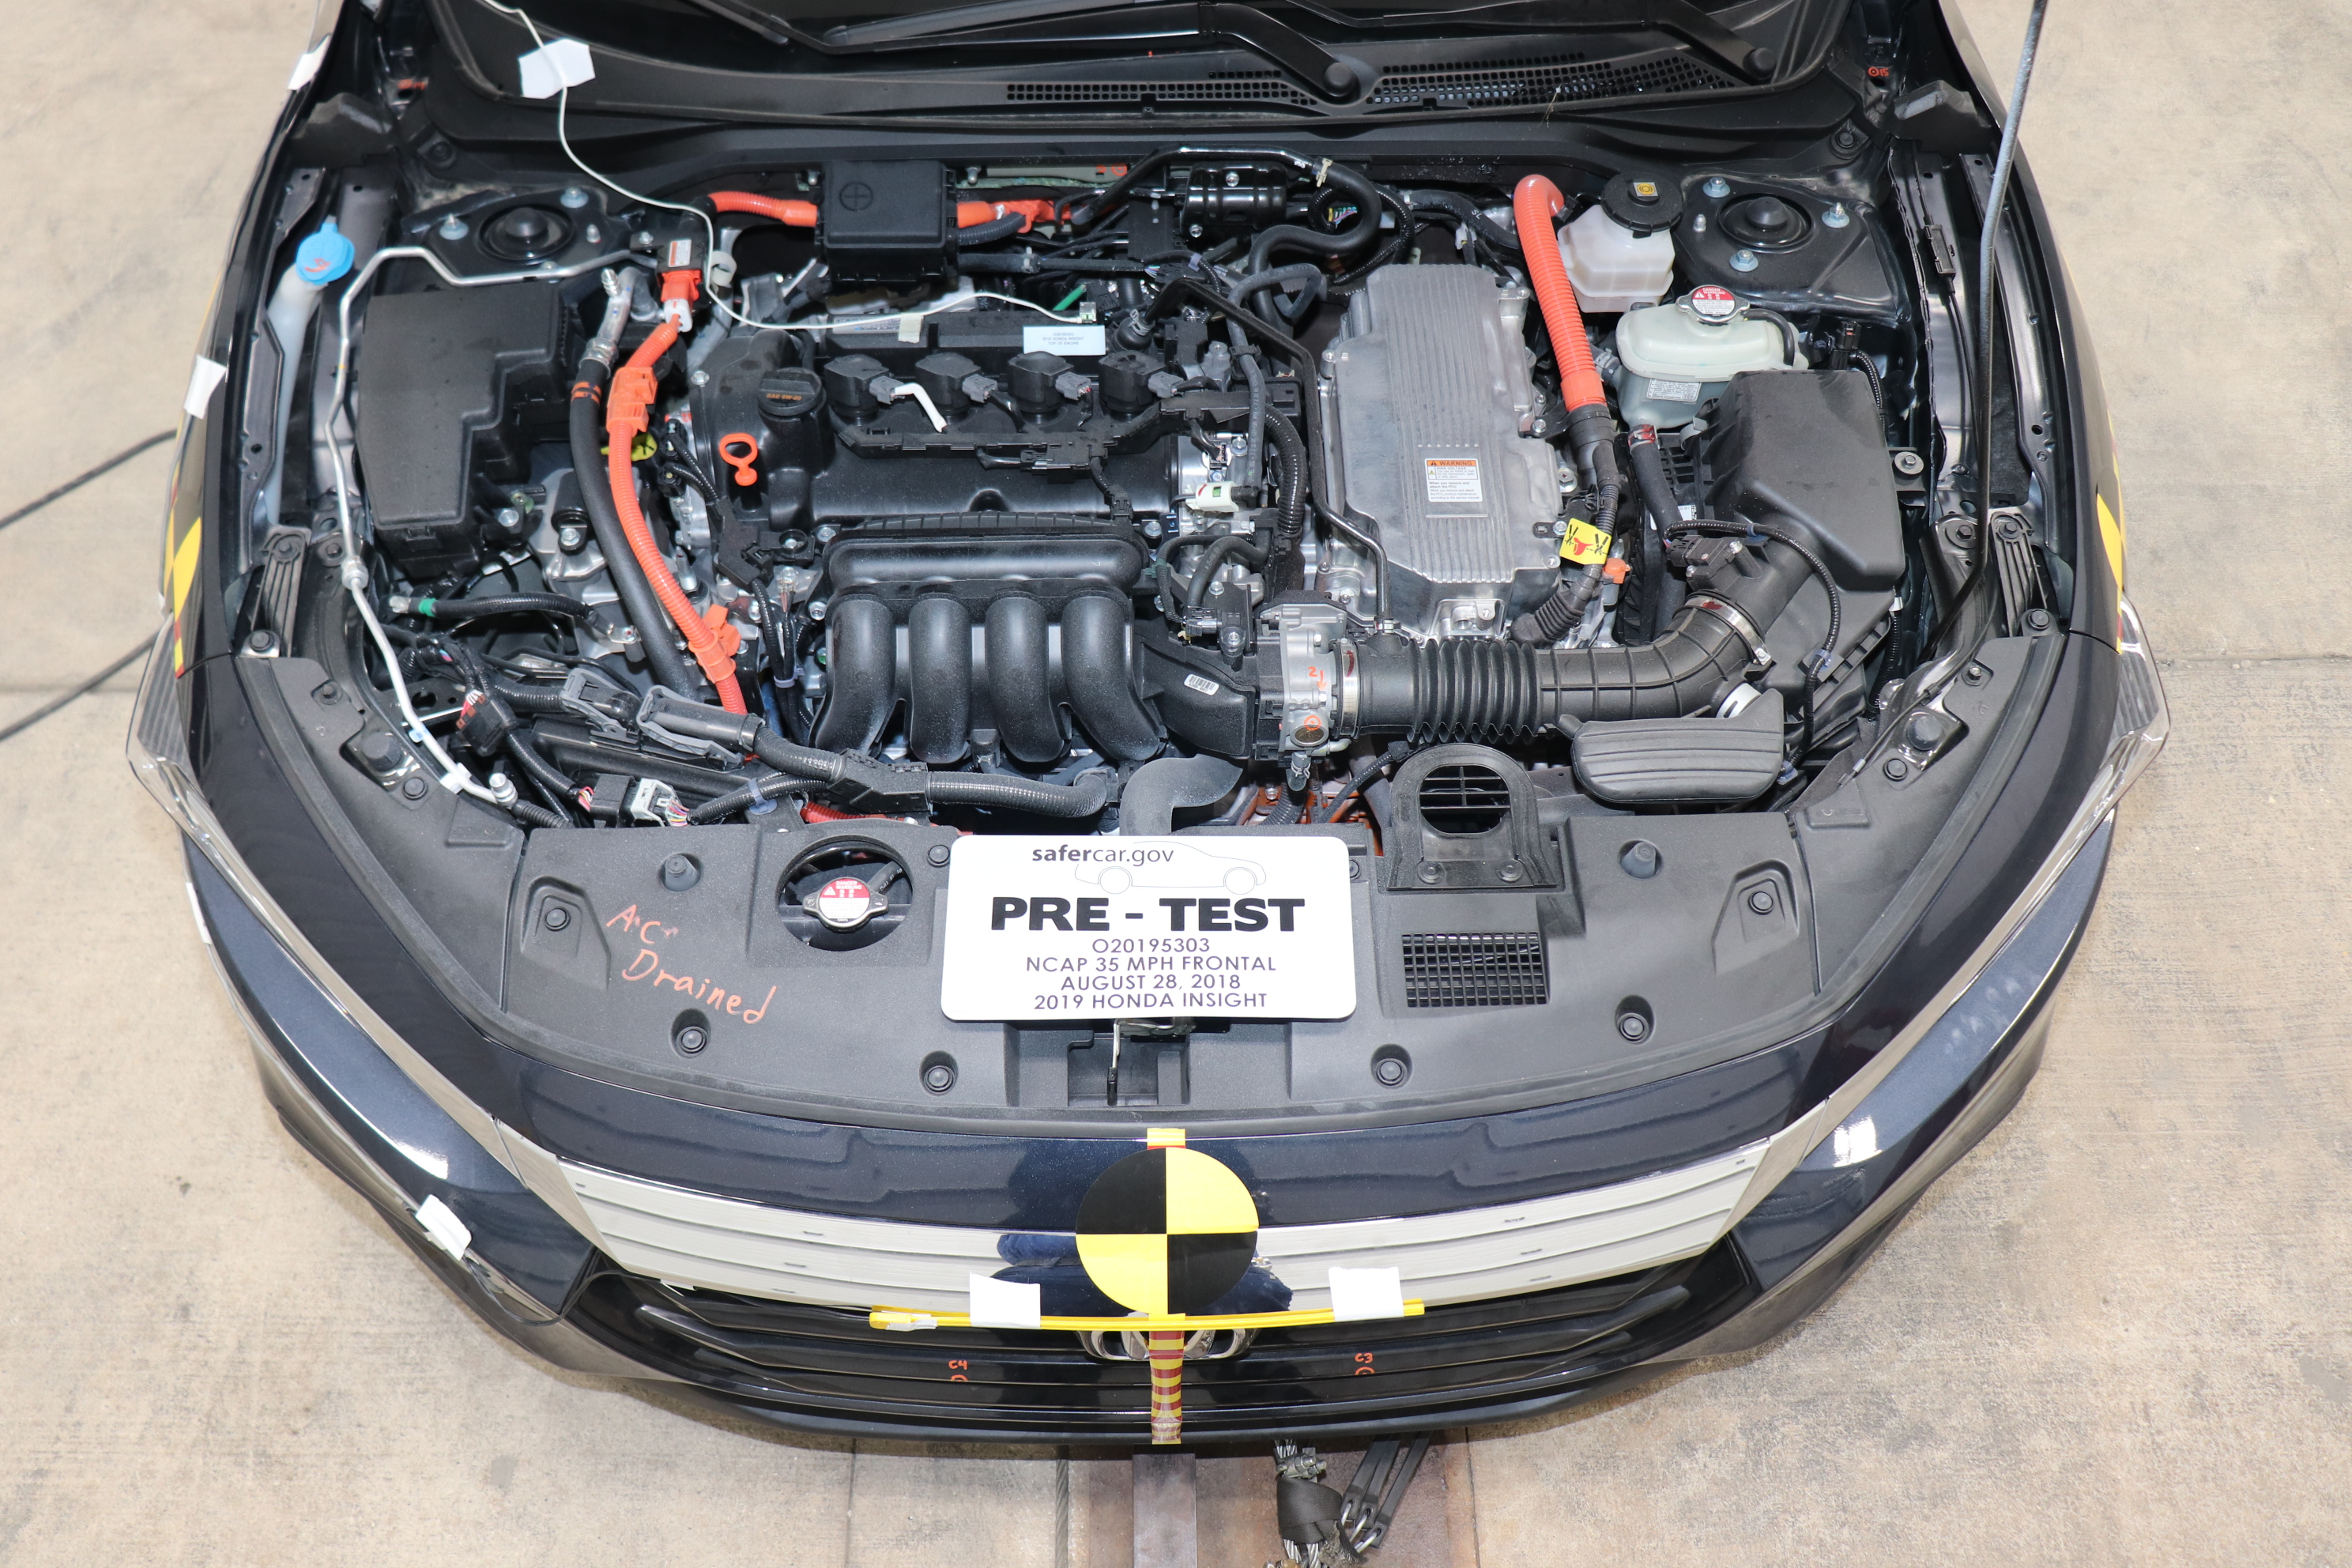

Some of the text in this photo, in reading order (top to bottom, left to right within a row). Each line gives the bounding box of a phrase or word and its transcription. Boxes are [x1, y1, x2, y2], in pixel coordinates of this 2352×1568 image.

[1032, 844, 1174, 867] safercar.gov
[991, 896, 1110, 932] PRE
[1159, 898, 1306, 932] TEST
[1027, 956, 1276, 973] NCAP 35 MPH FRONTAL
[622, 948, 778, 1024] Drained
[1061, 974, 1241, 991] AUGUST 28, 2018
[1034, 993, 1268, 1010] 2019 HONDA INSIGHT
[948, 1359, 968, 1370] C4
[1354, 1352, 1374, 1364] C3
